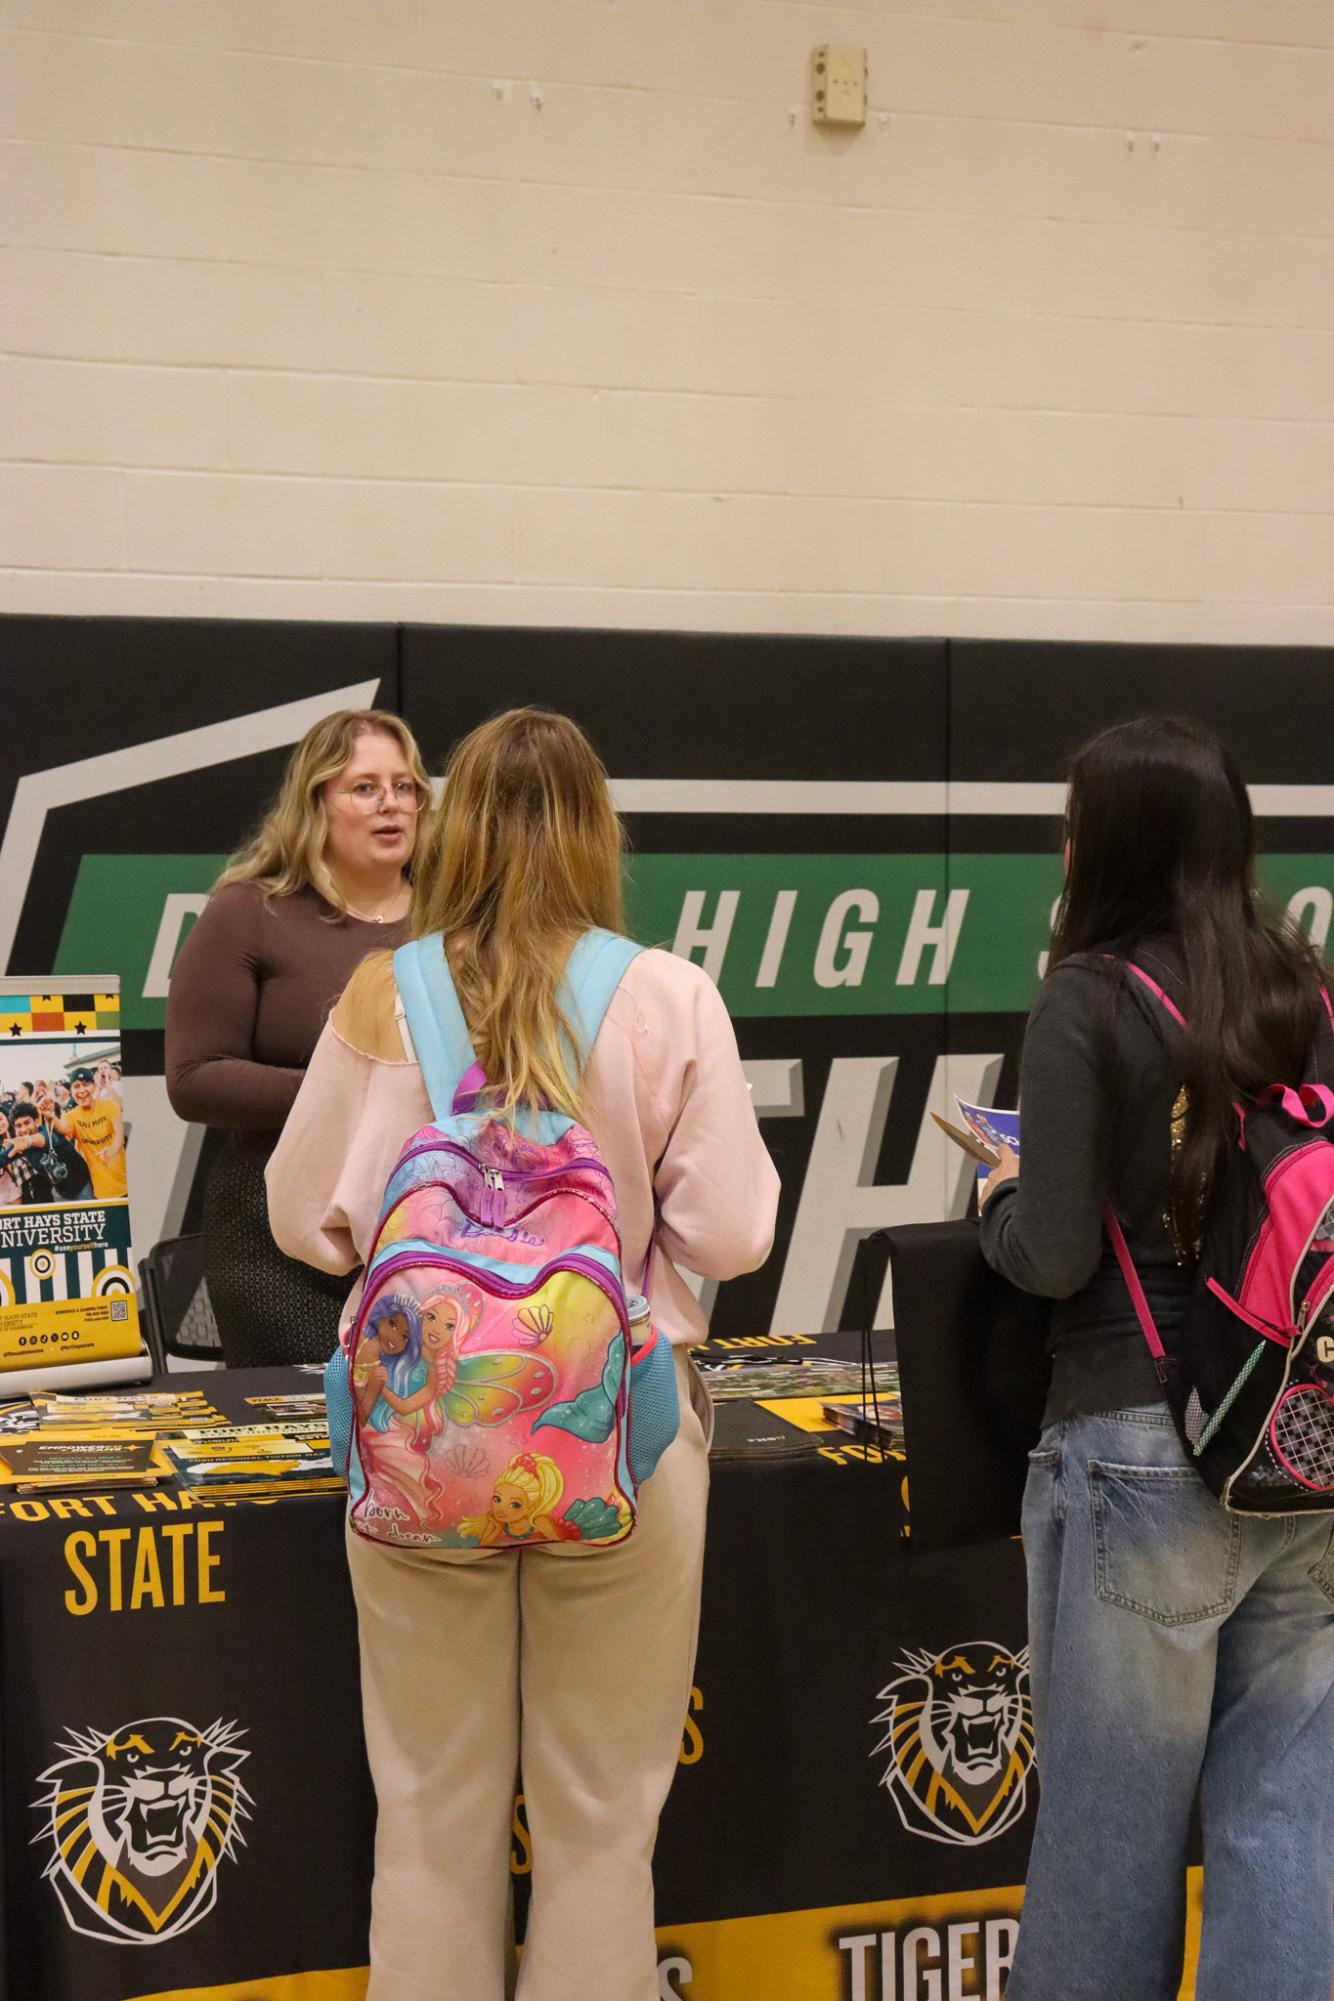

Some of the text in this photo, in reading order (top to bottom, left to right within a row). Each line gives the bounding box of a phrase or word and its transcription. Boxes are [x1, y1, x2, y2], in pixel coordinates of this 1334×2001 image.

[670, 888, 971, 988] HIGH
[1, 1223, 106, 1248] NIVERSITY
[24, 1214, 61, 1228] HAYS
[63, 1210, 106, 1225] STATE
[364, 1487, 411, 1521] born
[63, 1520, 226, 1616] STATE
